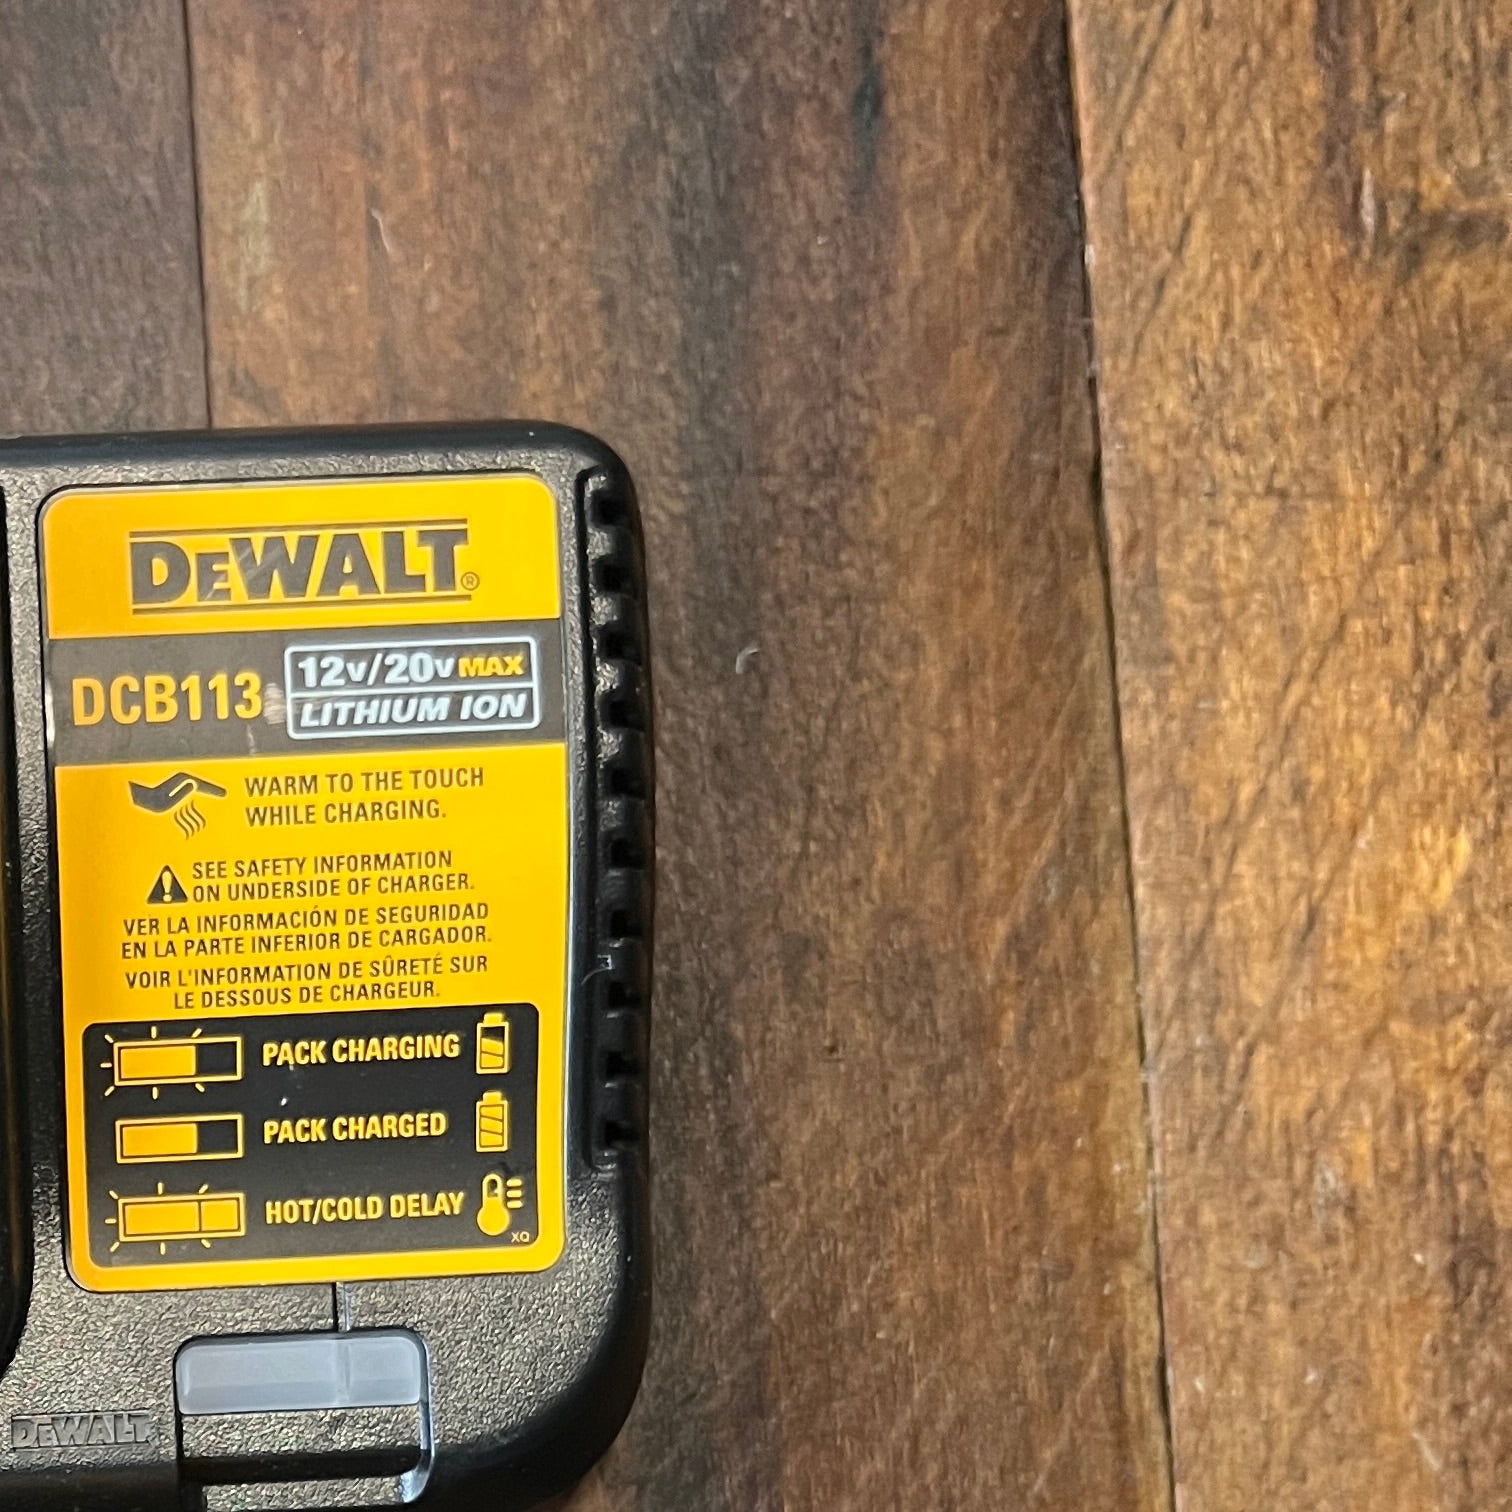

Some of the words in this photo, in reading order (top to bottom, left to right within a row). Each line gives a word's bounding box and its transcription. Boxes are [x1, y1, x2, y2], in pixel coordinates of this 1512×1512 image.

[459, 653, 523, 677] MAX
[73, 670, 262, 725] DCB113
[301, 697, 450, 727] LITHIUM
[461, 693, 527, 719] ION
[245, 775, 318, 797] WARM
[325, 773, 353, 793] TO
[361, 771, 402, 791] THE
[410, 767, 484, 789] TOUCH
[246, 804, 316, 827] WHILE
[325, 799, 446, 823] CHARGING.
[193, 861, 227, 879] SEE
[234, 857, 306, 877] SAFETY
[314, 850, 451, 874] INFORMATION
[193, 885, 219, 902] ON
[228, 879, 340, 901] UNDERSIDE
[348, 877, 371, 895] OF
[378, 873, 474, 894] CHARGER.
[123, 918, 159, 936] VER
[167, 917, 189, 934] LA
[197, 905, 337, 933] INFORMACIÓN
[345, 908, 368, 925] DE
[376, 903, 488, 924] SEGURIDAD
[122, 942, 146, 959] EN
[155, 940, 177, 957] LA
[185, 937, 244, 956] PARTE
[252, 933, 340, 953] INFERIOR
[348, 931, 371, 948] DE
[379, 926, 491, 947] CARGADOR.
[126, 971, 170, 989] VOIR
[178, 963, 332, 987] L'INFORMATION
[339, 961, 362, 979] DE
[369, 955, 443, 977] SÛRETÉ
[450, 956, 487, 973] SUR
[175, 992, 194, 1009] LE
[202, 987, 291, 1008] DESSOUS
[299, 986, 322, 1003] DE
[330, 981, 440, 1003] CHARGEUR.
[262, 1041, 327, 1067] PACK
[333, 1034, 459, 1062] CHARGING
[264, 1119, 326, 1143] PACK
[333, 1113, 446, 1140] CHARGED
[266, 1196, 383, 1224] HOT/COLD
[391, 1192, 464, 1217] DELAY
[12, 1412, 150, 1449] DEWALT
